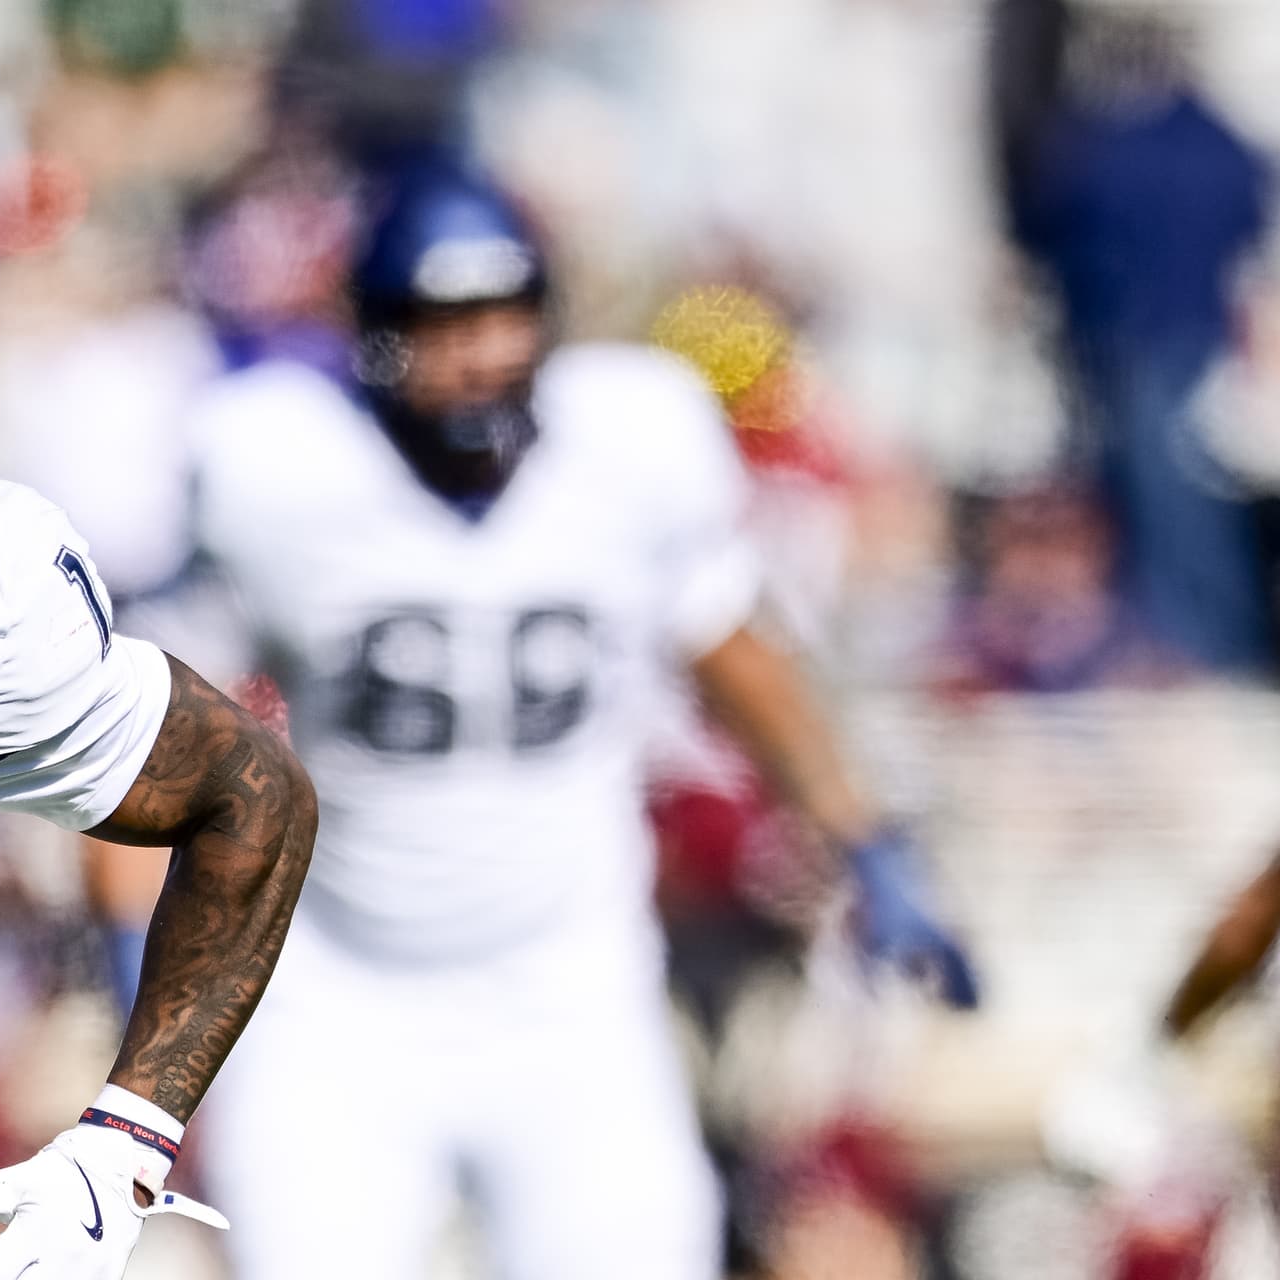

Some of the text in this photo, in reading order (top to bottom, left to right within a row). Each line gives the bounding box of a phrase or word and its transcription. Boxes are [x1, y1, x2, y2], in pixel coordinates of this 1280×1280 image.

[54, 545, 112, 663] 1
[104, 1116, 131, 1132] Acta
[133, 1126, 155, 1141] Non
